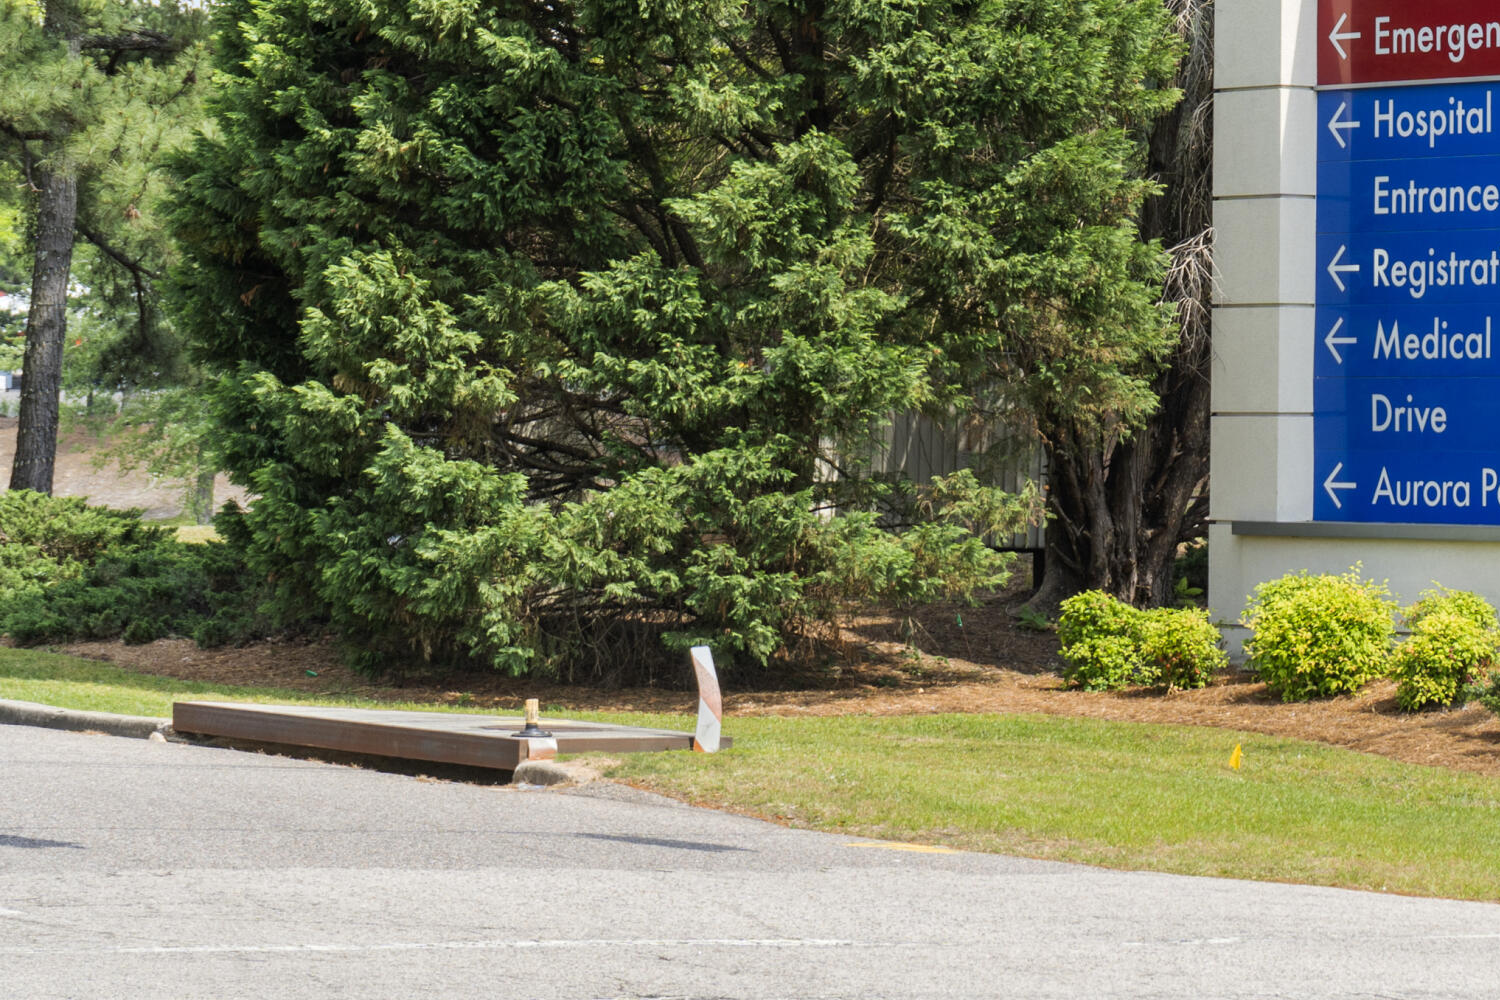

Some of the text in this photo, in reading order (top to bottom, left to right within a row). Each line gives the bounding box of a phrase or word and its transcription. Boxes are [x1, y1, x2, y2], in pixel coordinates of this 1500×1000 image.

[1374, 90, 1492, 148] Hospital
[1374, 176, 1499, 214] Entrance
[1373, 316, 1491, 360] Medical
[1371, 394, 1447, 433] Drive
[1372, 466, 1470, 507] Aurora
